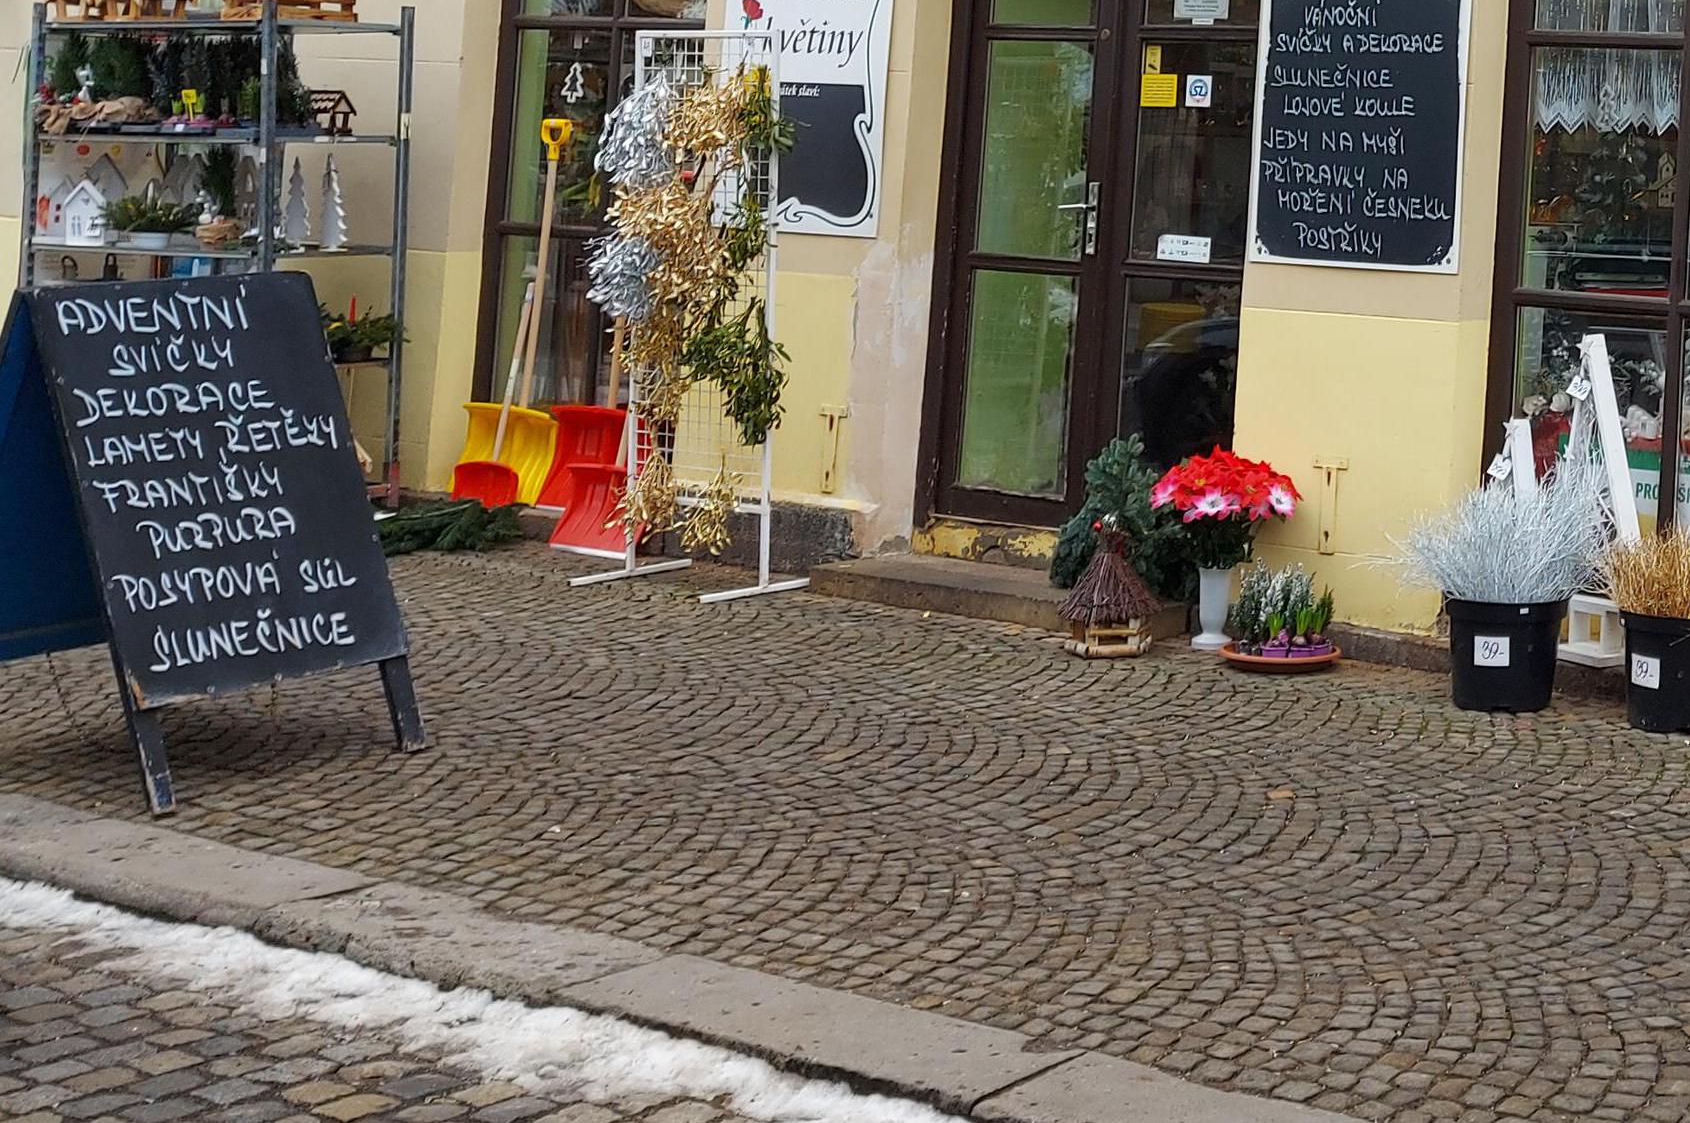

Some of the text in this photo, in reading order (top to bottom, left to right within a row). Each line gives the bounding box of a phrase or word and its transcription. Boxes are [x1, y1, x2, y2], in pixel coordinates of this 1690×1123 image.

[1276, 27, 1444, 55] SVÍČKY A DEKORACE
[1270, 63, 1394, 90] SLUNEČNICE
[1283, 92, 1415, 117] LOJOVÉ KOULE
[1263, 127, 1405, 156] JEDY NA MYŠI
[1260, 157, 1408, 190] PŘÍPRAVKY NA
[1277, 187, 1452, 222] MOŘENÍ ČESNEKU
[1292, 221, 1382, 258] POSTŘIKY
[56, 285, 250, 336] ADVENTNÍ
[107, 334, 235, 377] SVÍČKY
[71, 378, 275, 428] DEKORACE
[92, 460, 285, 514] FRANTIŠKY
[135, 506, 297, 560] PURPURA
[111, 551, 283, 614] POSYPOVÁ
[149, 607, 356, 673] SLUNEČNICE
